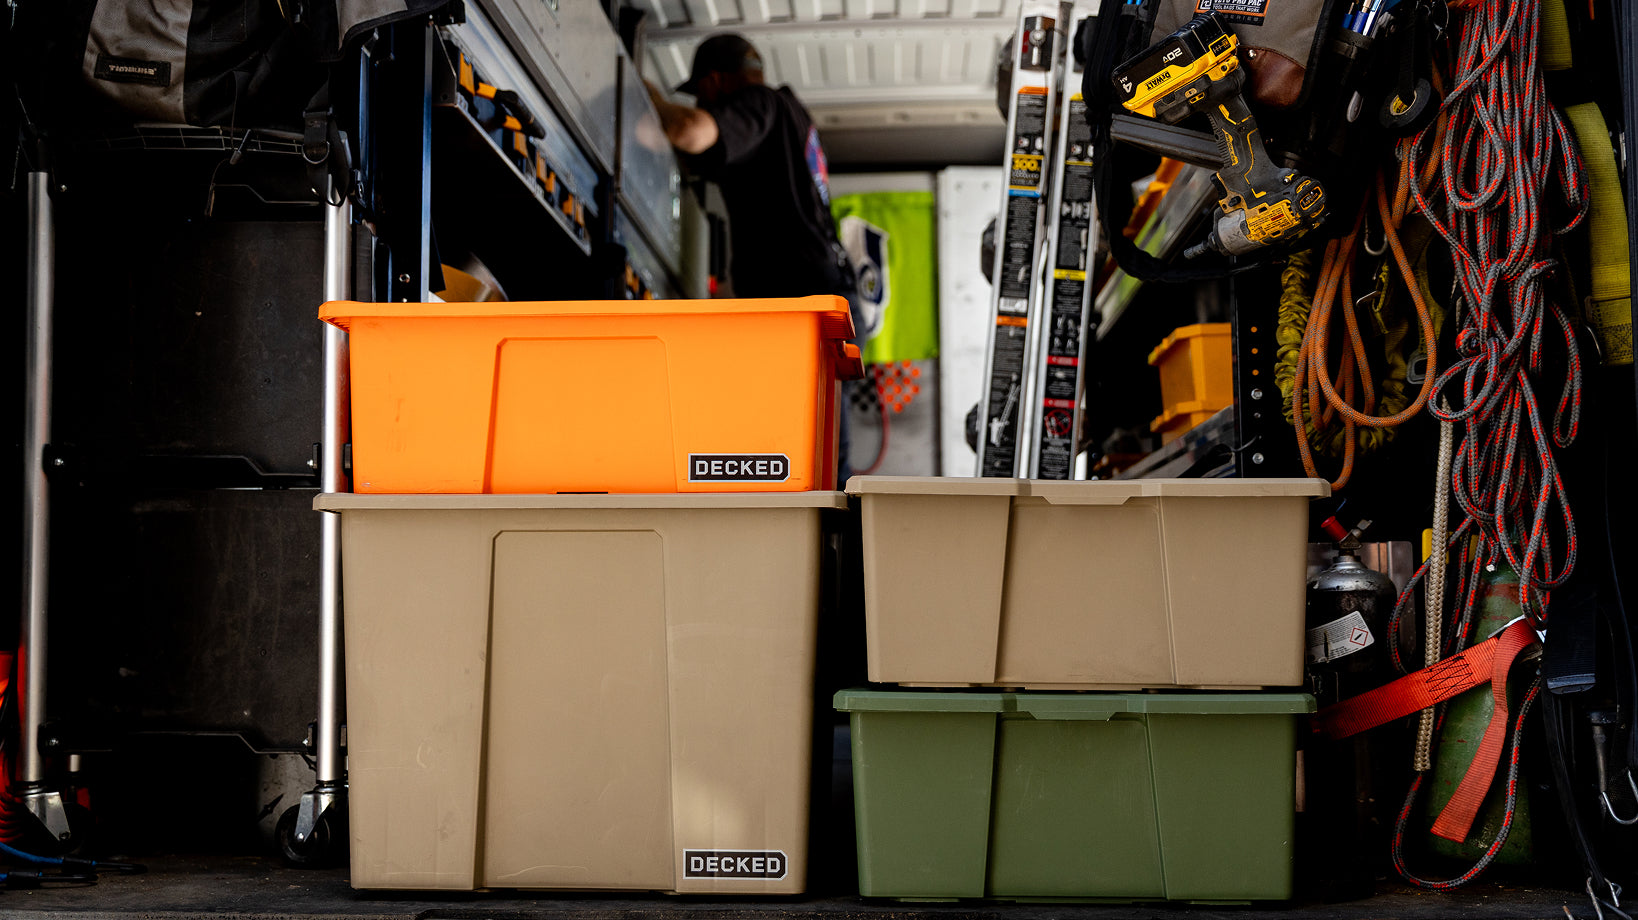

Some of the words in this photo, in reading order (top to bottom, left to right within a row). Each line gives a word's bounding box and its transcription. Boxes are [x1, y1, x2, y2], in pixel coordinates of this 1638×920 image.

[1162, 47, 1183, 64] 20V
[1122, 82, 1133, 93] 4
[695, 460, 783, 476] DECKED
[690, 856, 781, 873] DECKED
